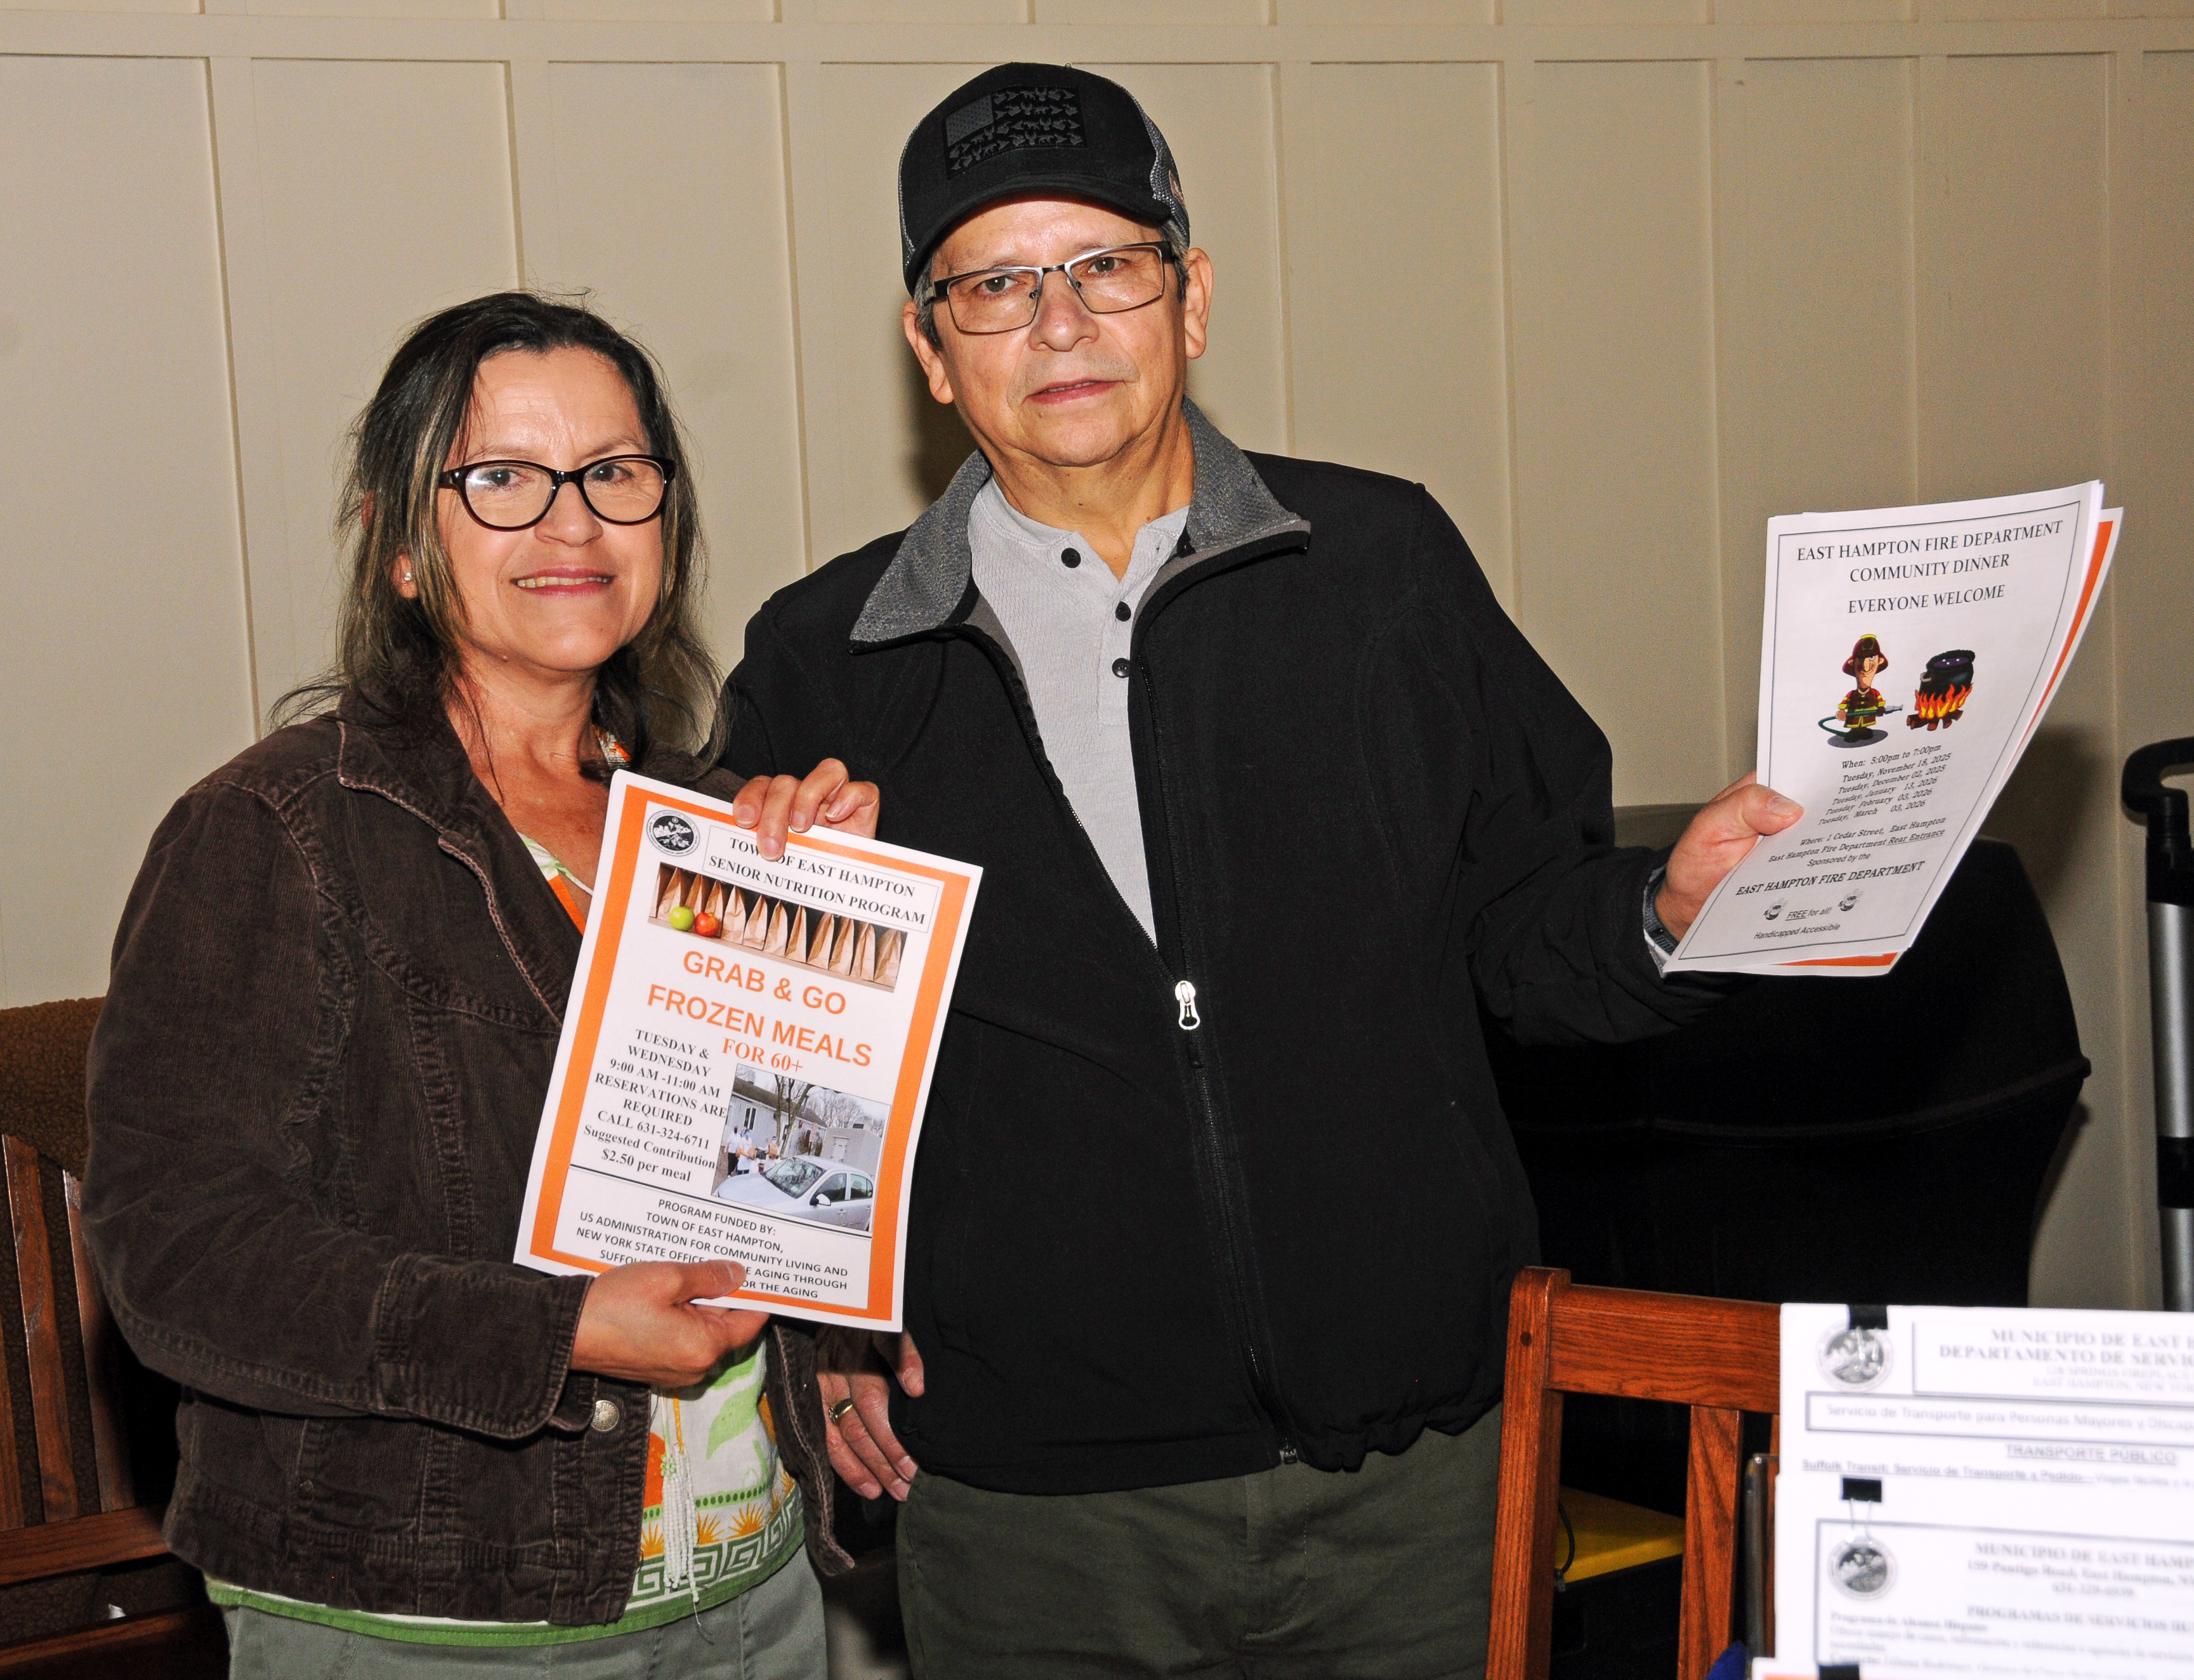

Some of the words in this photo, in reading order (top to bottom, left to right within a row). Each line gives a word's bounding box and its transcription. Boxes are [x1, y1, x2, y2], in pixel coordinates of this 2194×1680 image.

[1797, 546, 1834, 561] EAST
[1839, 539, 1921, 558] HAMPTON
[1925, 535, 1959, 551] FIRE
[1962, 520, 2063, 548] DEPARTMENT
[1849, 561, 1949, 582] COMMUNITY
[1953, 553, 2010, 574] DINNER
[1848, 594, 1929, 614] EVERYONE
[1933, 584, 2006, 607] WELCOME
[1843, 759, 1866, 769] When:
[1870, 754, 1900, 765] 5:00pm
[1912, 745, 1941, 756] 7:00pm
[1843, 771, 1875, 783] Tuesday,
[1877, 763, 1915, 777] November
[1917, 759, 1928, 767] 18,
[1930, 752, 1952, 764] 2025
[1865, 786, 1896, 798] January
[1917, 777, 1938, 787] 2026
[1872, 775, 1910, 787] December
[1925, 765, 1947, 775] 2025
[1853, 808, 1878, 818] March
[1905, 799, 1927, 810] 2026
[1858, 796, 1894, 808] February
[1912, 788, 1933, 799] 2026
[1768, 854, 1786, 862] East
[1785, 848, 1820, 860] Hampton
[1821, 844, 1837, 853] Fire
[1838, 838, 1887, 853] Department
[1888, 835, 1908, 845] Rear
[1908, 829, 1945, 842] Entrance
[1799, 836, 1825, 846] Where:
[1834, 830, 1856, 841] Cedar
[1889, 824, 1908, 833] East
[1908, 817, 1946, 830] Hampton
[730, 837, 761, 856] TOW
[777, 855, 795, 867] OF
[798, 859, 836, 877] EAST
[839, 869, 915, 897] HAMPTON
[1807, 855, 1846, 868] Sponsored
[1847, 853, 1858, 863] by
[1858, 852, 1871, 860] the
[709, 855, 761, 881] SENIOR
[764, 872, 845, 904] NUTRITION
[849, 896, 926, 924] PROGRAM
[1735, 883, 1764, 896] EAST
[1764, 876, 1818, 891] HAMPTON
[1818, 872, 1846, 884] FIRE
[1847, 860, 1926, 881] DEPARTMENT
[1785, 909, 1808, 921] FREE
[1754, 927, 1801, 940] Handicapped
[1800, 922, 1841, 934] Accessible
[683, 950, 766, 993] GRAB
[773, 978, 792, 1002] &
[803, 985, 846, 1015] GO
[647, 983, 765, 1038] FROZEN
[772, 1020, 872, 1067] MEALS
[636, 1028, 697, 1055] TUESDAY
[699, 1048, 709, 1060] &
[722, 1037, 765, 1065] FOR
[771, 1053, 803, 1072] 60+
[628, 1045, 711, 1077] WEDNESDAY
[610, 1058, 634, 1074] 9:00
[636, 1066, 659, 1081] AM
[699, 1084, 721, 1098] AM
[595, 1072, 698, 1110] RESERVATIONS
[700, 1103, 728, 1119] ARE
[623, 1098, 692, 1126] REQUIRED
[598, 1110, 634, 1129] CALL
[637, 1121, 709, 1150] 631-324-6711
[584, 1124, 640, 1149] Suggested
[644, 1141, 716, 1169] Contribution
[601, 1148, 634, 1166] $2.50
[637, 1160, 659, 1172] per
[661, 1167, 692, 1182] meal
[646, 1212, 679, 1228] TOWN
[681, 1221, 695, 1231] OF
[699, 1225, 724, 1238] EAST
[726, 1231, 784, 1254] HAMPTON,
[658, 1199, 712, 1220] PROGRAM
[714, 1213, 757, 1231] FUNDED
[759, 1224, 776, 1236] BY:
[576, 1227, 602, 1241] NEW
[605, 1234, 633, 1249] YORK
[634, 1242, 666, 1257] STATE
[669, 1250, 705, 1264] OFFICE
[755, 1268, 790, 1281] AGING
[793, 1274, 847, 1290] THROUGH
[580, 1211, 594, 1223] US
[596, 1216, 687, 1247] ADMINISTRATION
[690, 1239, 711, 1252] FOR
[714, 1245, 783, 1266] COMMUNITY
[785, 1259, 821, 1273] LIVING
[824, 1266, 848, 1276] AND
[600, 1249, 642, 1265] SUFFO
[742, 1280, 756, 1289] OR
[759, 1282, 780, 1292] THE
[783, 1286, 818, 1299] AGING
[1990, 1328, 2096, 1346] MUNICIPIO
[2101, 1332, 2125, 1347] DE
[2132, 1333, 2181, 1349] EAST
[1939, 1344, 2094, 1363] DEPARTAMENTO
[2099, 1349, 2125, 1365] DE
[1827, 1403, 1877, 1417] Servicio
[1881, 1406, 1896, 1417] de
[1901, 1407, 1971, 1423] Transporte
[1976, 1411, 2004, 1424] para
[2009, 1411, 2070, 1425] Personas
[2073, 1414, 2132, 1428] Mayores
[2005, 1443, 2105, 1460] TRANSPORTE
[2109, 1447, 2176, 1464] PÚBLICO
[1802, 1459, 1842, 1470] Suffolk
[1893, 1463, 1940, 1475] Servicio
[1943, 1466, 1958, 1476] de
[1962, 1466, 2025, 1480] Transporte
[1975, 1541, 2066, 1560] MUNICIPIO
[2071, 1548, 2092, 1562] DE
[2098, 1550, 2140, 1565] EAST
[1966, 1605, 2061, 1622] PROGRAMAS
